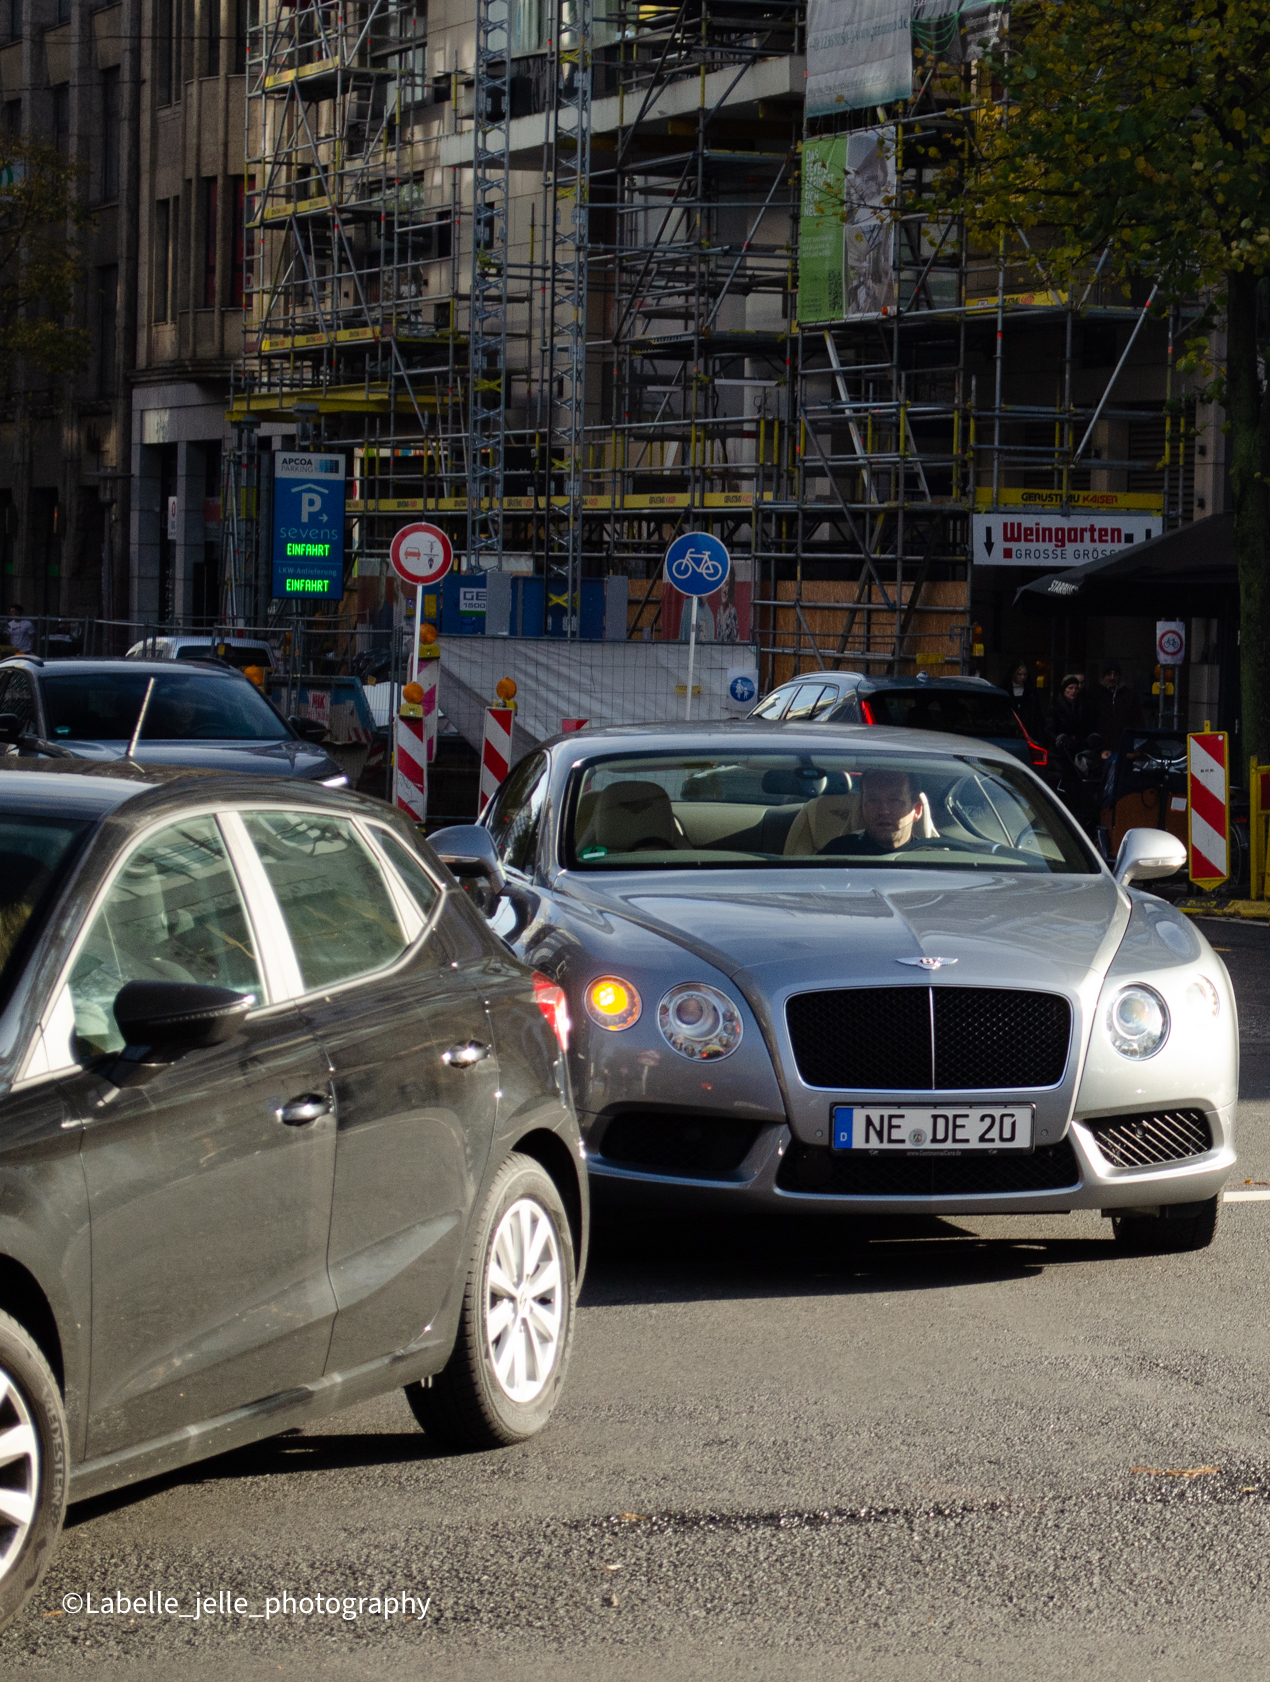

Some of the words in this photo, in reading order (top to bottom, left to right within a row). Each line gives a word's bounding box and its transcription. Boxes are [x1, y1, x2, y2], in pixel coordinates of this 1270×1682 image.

[281, 458, 313, 466] APCOA
[281, 465, 314, 473] PARKING
[301, 493, 322, 523] P
[280, 527, 338, 540] sevens
[1003, 522, 1122, 548] Weingarten
[287, 543, 330, 556] EINFAHRT
[1015, 549, 1067, 560] GROSSE
[279, 566, 337, 577] LKW-Anlieferung
[286, 579, 329, 592] EINFAHRT
[864, 1114, 906, 1144] NE
[930, 1113, 970, 1144] DE
[978, 1113, 1016, 1143] 20
[840, 1132, 848, 1142] D
